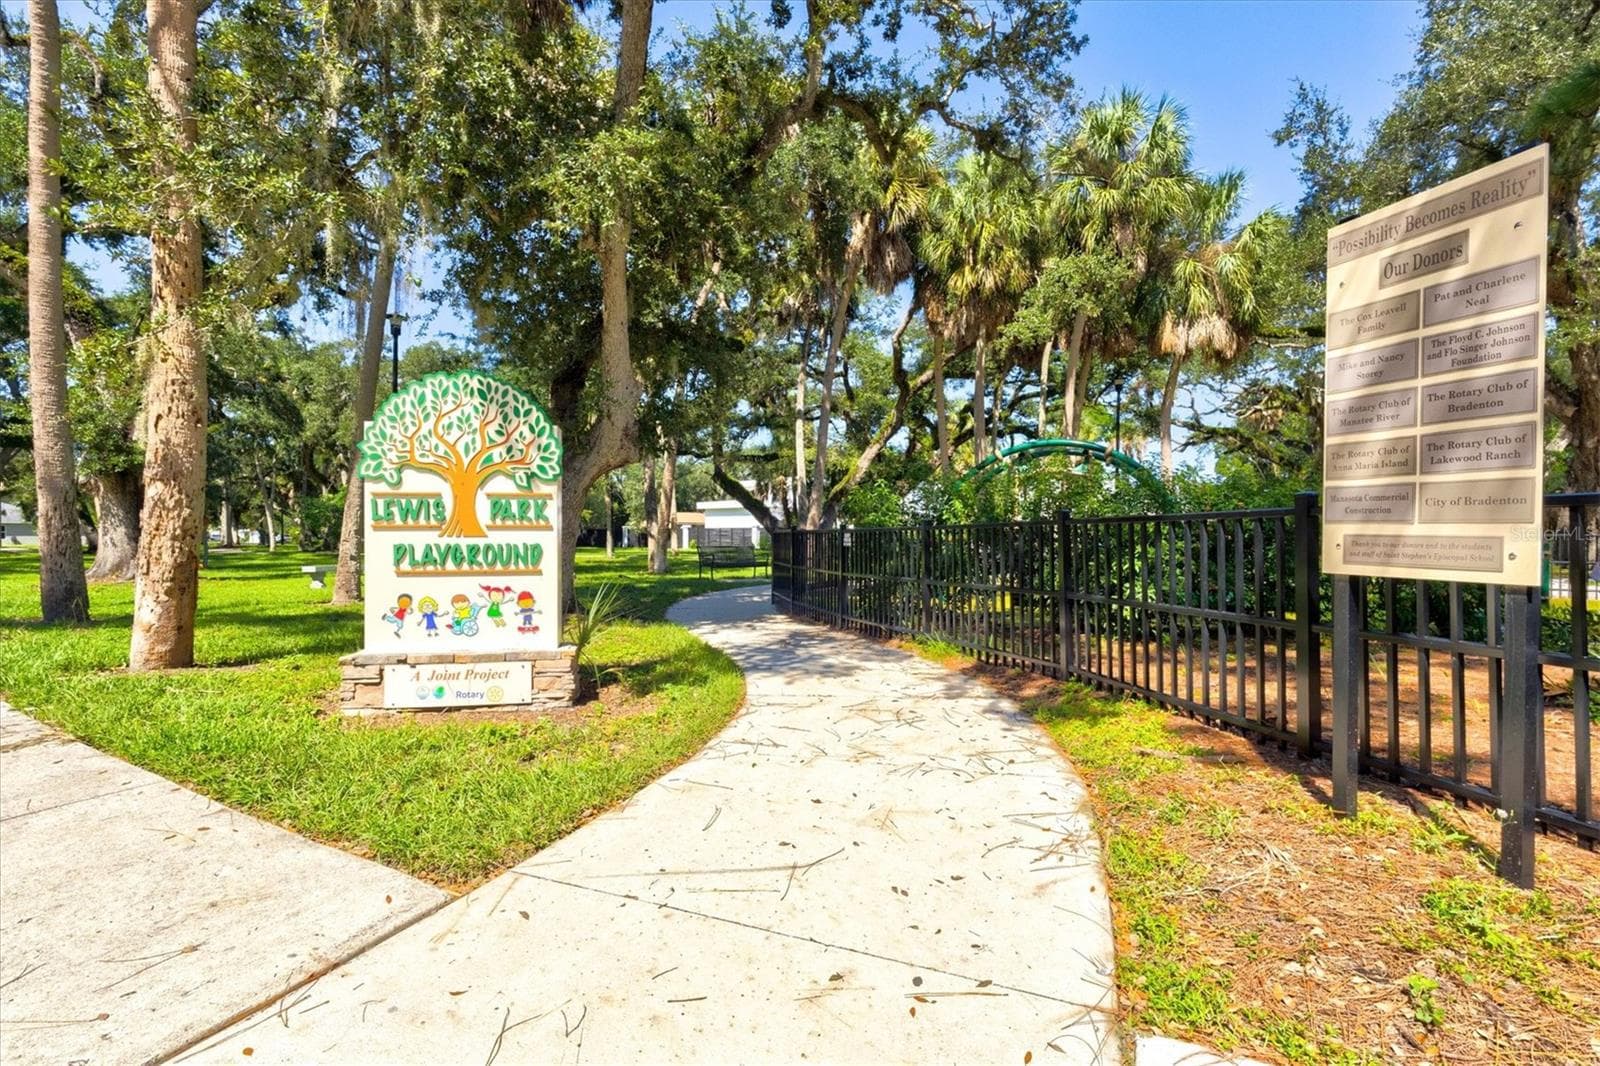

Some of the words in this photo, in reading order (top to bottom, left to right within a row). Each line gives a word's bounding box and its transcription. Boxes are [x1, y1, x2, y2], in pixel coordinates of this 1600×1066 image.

[1404, 201, 1466, 233] Becomes
[1383, 260, 1409, 280] Our
[1413, 244, 1464, 271] Donors
[1434, 292, 1450, 302] Pat
[1453, 285, 1472, 298] and
[1475, 272, 1526, 291] Charlene
[1465, 294, 1490, 308] Neal
[1340, 317, 1355, 327] The
[1356, 313, 1372, 322] Cox
[1357, 321, 1385, 335] Family
[1430, 339, 1447, 348] The
[1449, 331, 1473, 346] Floyd
[1475, 330, 1484, 339] C.
[1486, 322, 1526, 337] Johnson
[1427, 350, 1442, 360] and
[1444, 347, 1458, 357] Flo
[1460, 342, 1489, 355] Singer
[1490, 334, 1531, 348] Johnson
[1338, 362, 1357, 371] Mike
[1360, 357, 1376, 367] and
[1377, 353, 1405, 364] Nancy
[1450, 351, 1502, 368] Foundation
[1356, 370, 1385, 380] Storey
[1427, 393, 1446, 402] The
[1448, 388, 1483, 400] Rotary
[1487, 382, 1513, 394] Club
[1516, 379, 1529, 389] of
[1332, 407, 1347, 416] The
[1348, 404, 1376, 414] Rotary
[1378, 399, 1399, 410] Club
[1401, 397, 1412, 406] of
[1447, 400, 1504, 413] Bradenton
[1340, 417, 1374, 427] Manatee
[1376, 413, 1400, 423] River
[1426, 442, 1445, 452] The
[1447, 439, 1483, 450] Rotary
[1486, 435, 1512, 446] Club
[1514, 433, 1527, 444] of
[1331, 452, 1345, 461] The
[1347, 450, 1375, 459] Rotary
[1377, 447, 1398, 456] Club
[1400, 445, 1411, 454] of
[1430, 452, 1482, 465] Lakewood
[1485, 449, 1521, 461] Ranch
[1333, 464, 1353, 472] Anna
[1354, 461, 1379, 470] Maria
[1381, 459, 1409, 469] Island
[1363, 492, 1409, 501] Commercial
[1425, 496, 1447, 508] City
[1450, 496, 1461, 506] of
[1464, 496, 1527, 506] Bradenton
[370, 496, 447, 524] LEWIS
[490, 497, 550, 524] PARK
[1344, 505, 1392, 514] Construction
[392, 541, 544, 569] PLAYGROUND
[410, 671, 421, 682] A
[427, 669, 461, 681] Joint
[464, 668, 510, 683] Project
[455, 690, 485, 700] Rotary
